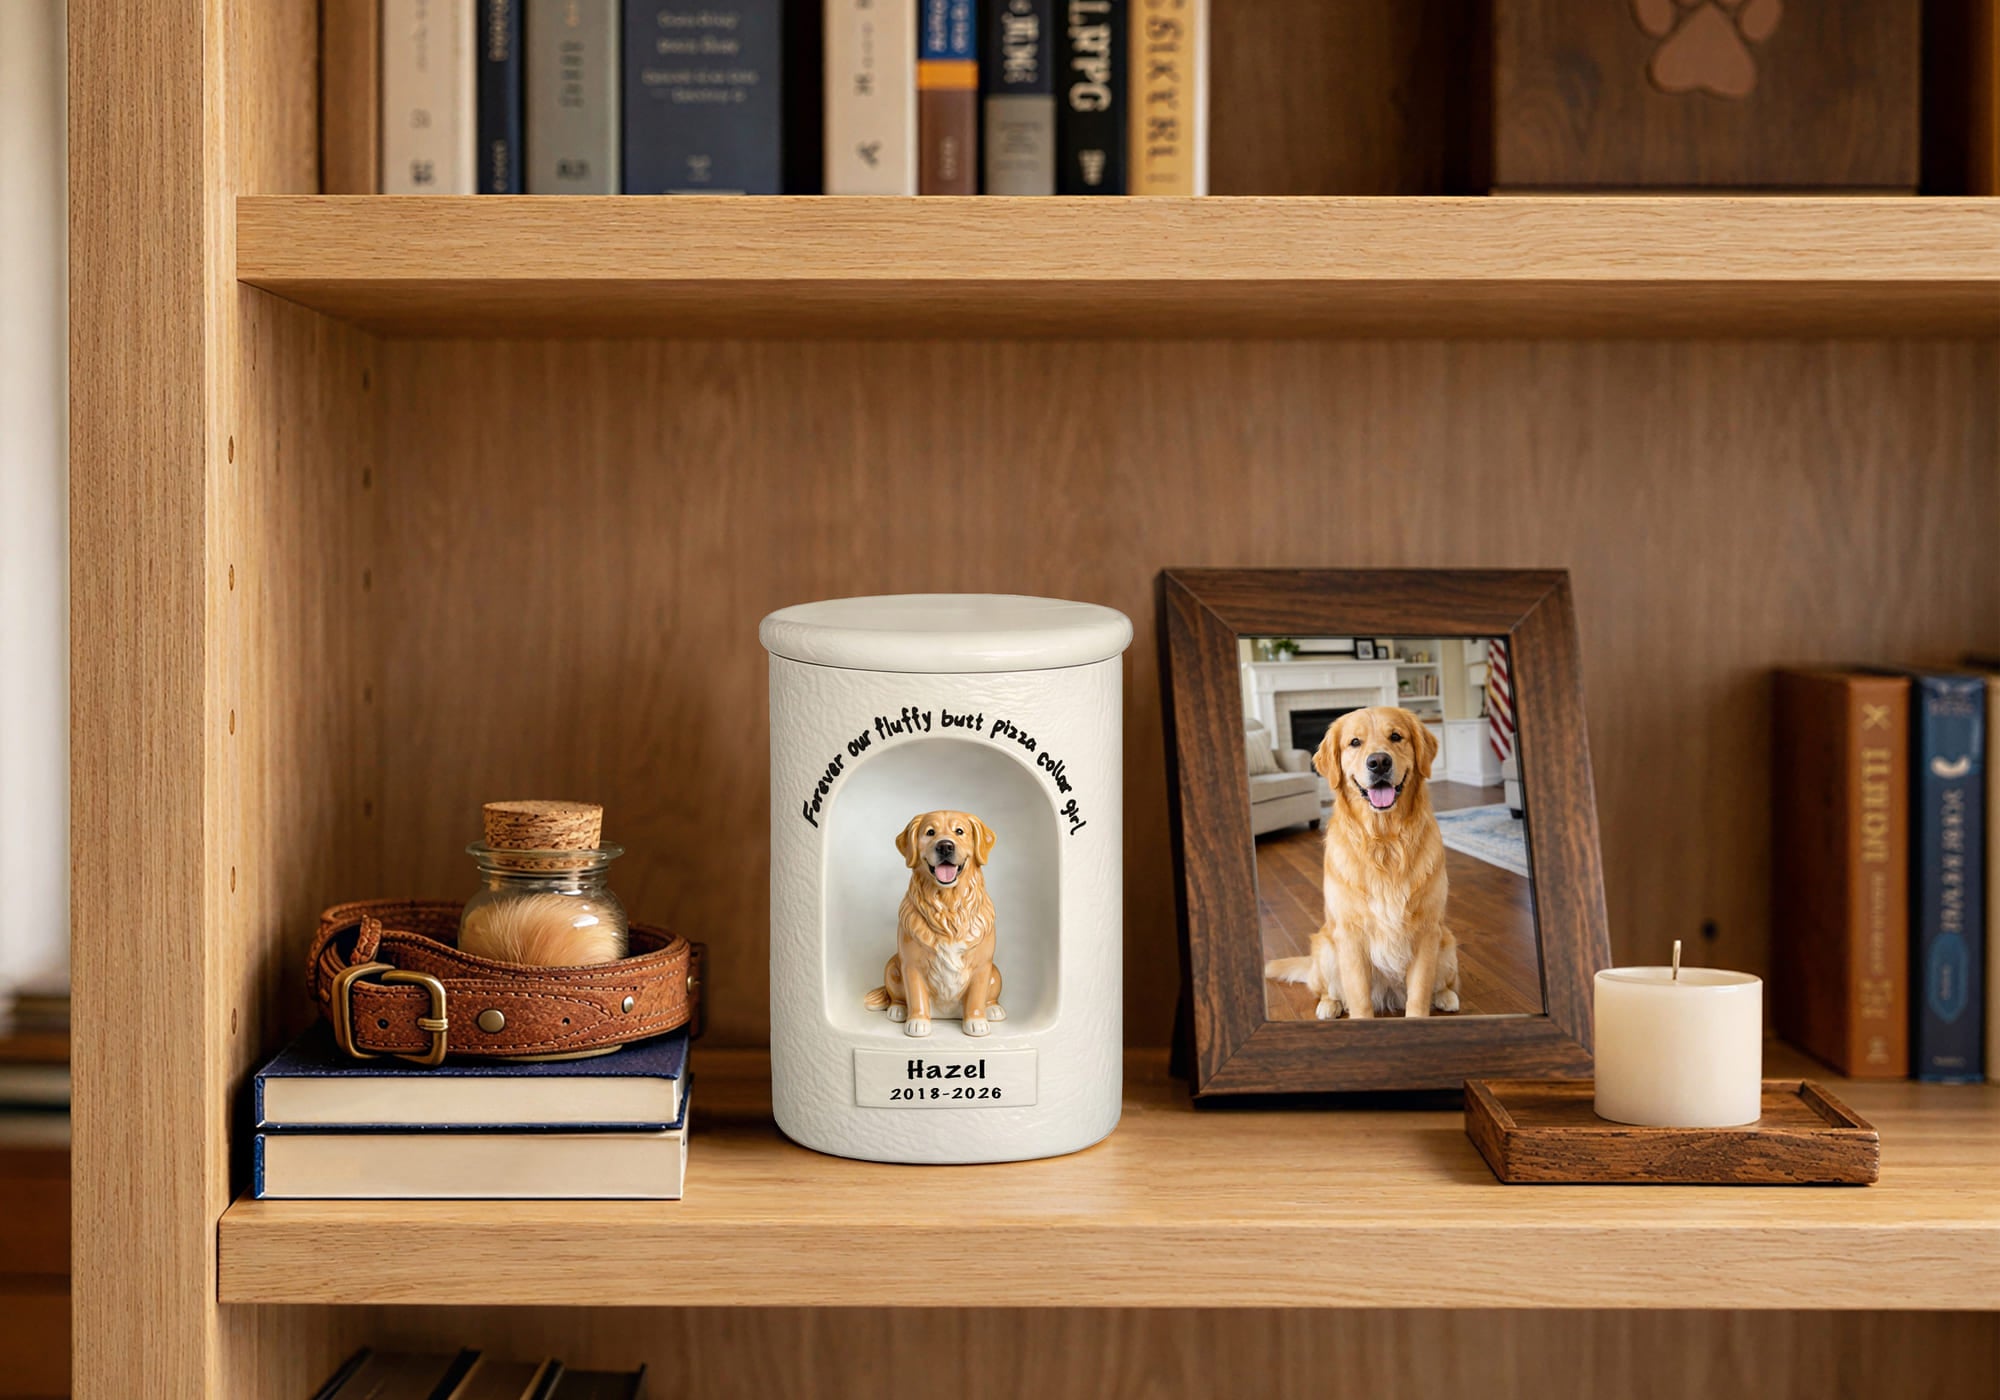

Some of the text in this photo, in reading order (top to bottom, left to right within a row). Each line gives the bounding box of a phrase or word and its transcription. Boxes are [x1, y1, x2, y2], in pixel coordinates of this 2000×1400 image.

[802, 706, 1087, 836] Forever our fluffy butt pizza collar girl
[907, 1059, 986, 1080] Hazel
[890, 1087, 1002, 1101] 2018-2026
